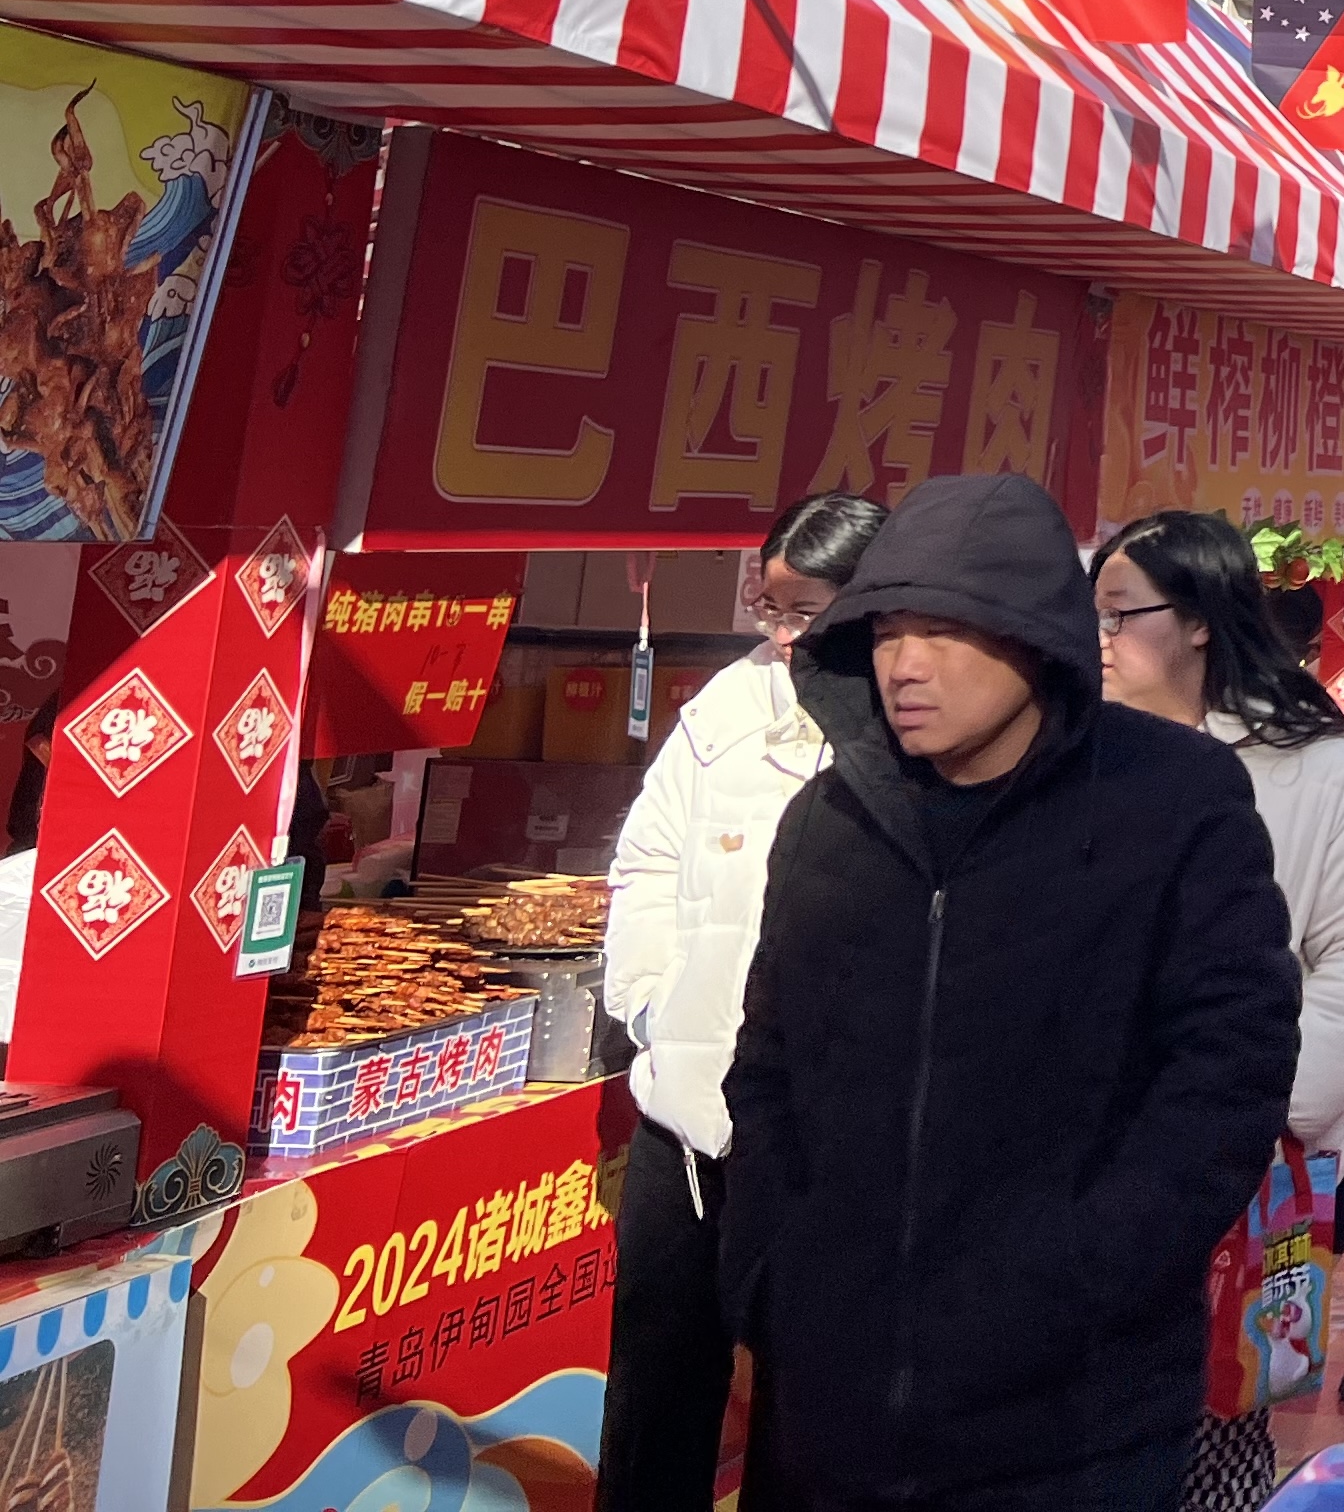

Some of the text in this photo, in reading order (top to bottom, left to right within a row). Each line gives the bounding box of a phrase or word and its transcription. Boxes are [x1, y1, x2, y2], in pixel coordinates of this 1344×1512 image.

[433, 194, 1061, 512] 巴西烤肉
[402, 678, 487, 716] 假一赔十
[346, 1023, 506, 1126] 蒙古烤肉
